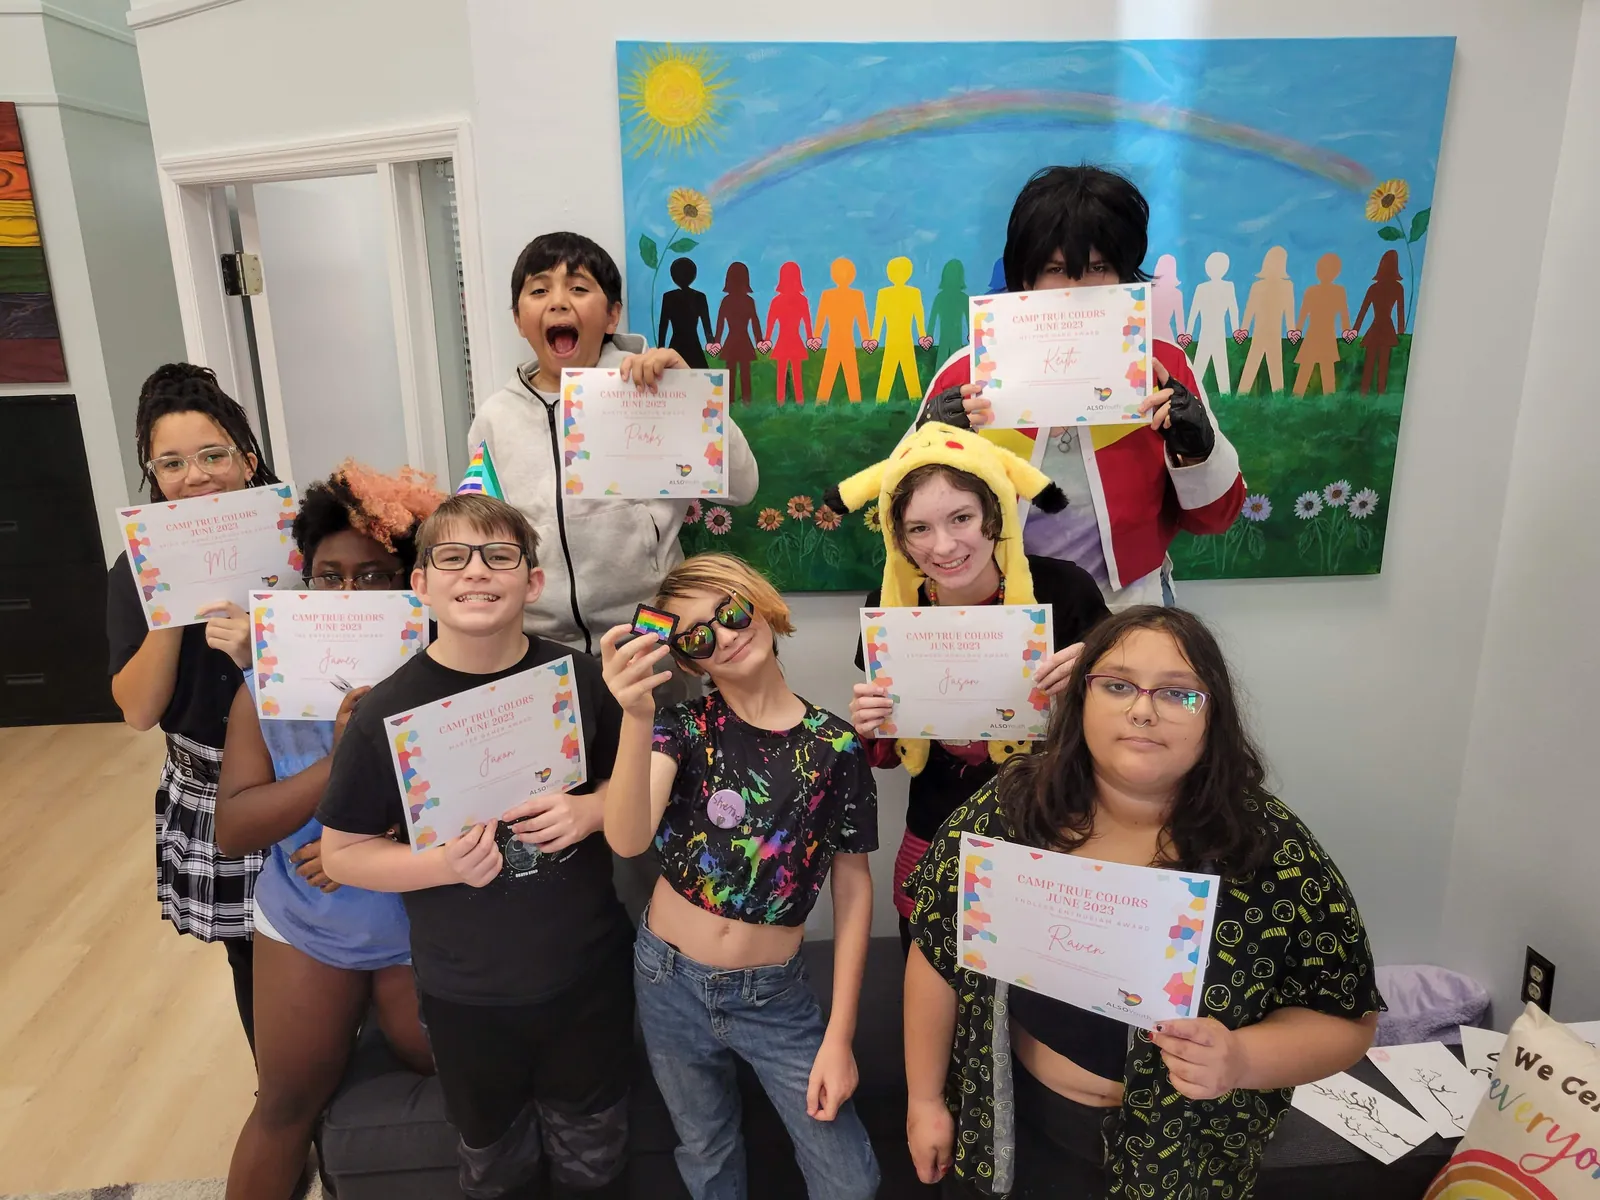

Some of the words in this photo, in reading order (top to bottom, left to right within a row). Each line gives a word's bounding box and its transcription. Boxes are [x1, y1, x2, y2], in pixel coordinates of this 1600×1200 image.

[1012, 314, 1039, 324] CAMP
[1041, 312, 1066, 322] TRUE
[1068, 309, 1106, 320] COLORS
[1034, 322, 1060, 332] JUNE
[1060, 322, 1084, 330] 2023
[1043, 346, 1082, 374] Keith
[600, 390, 625, 399] CAMP
[621, 400, 644, 408] JUNE
[645, 400, 667, 408] 2023
[624, 422, 666, 450] Parks
[166, 520, 193, 532] CAMP
[194, 516, 220, 527] TRUE
[221, 510, 258, 523] COLORS
[190, 526, 214, 537] JUNE
[216, 522, 239, 533] 2023
[292, 614, 319, 622] CAMP
[322, 614, 345, 622] TRUE
[347, 614, 384, 622] COLORS
[314, 623, 339, 632] JUNE
[340, 623, 363, 632] 2023
[906, 632, 934, 640] CAMP
[936, 632, 962, 640] TRUE
[964, 631, 1004, 640] COLORS
[930, 642, 955, 650] JUNE
[956, 642, 981, 650] 2023
[318, 648, 360, 674] James
[938, 667, 982, 696] Jason
[439, 718, 468, 736] CAMP
[470, 706, 496, 724] TRUE
[497, 694, 535, 714] COLORS
[464, 722, 490, 737] JUNE
[492, 712, 515, 728] 2023
[1017, 874, 1055, 892] CAMP
[1056, 880, 1093, 900] TRUE
[1095, 890, 1149, 910] COLORS
[1046, 892, 1081, 910] JUNE
[1082, 901, 1115, 916] 2023
[1116, 920, 1151, 932] AWARD
[1047, 924, 1106, 956] Raven
[1514, 1046, 1554, 1081] We
[1490, 1078, 1600, 1180] everyo
